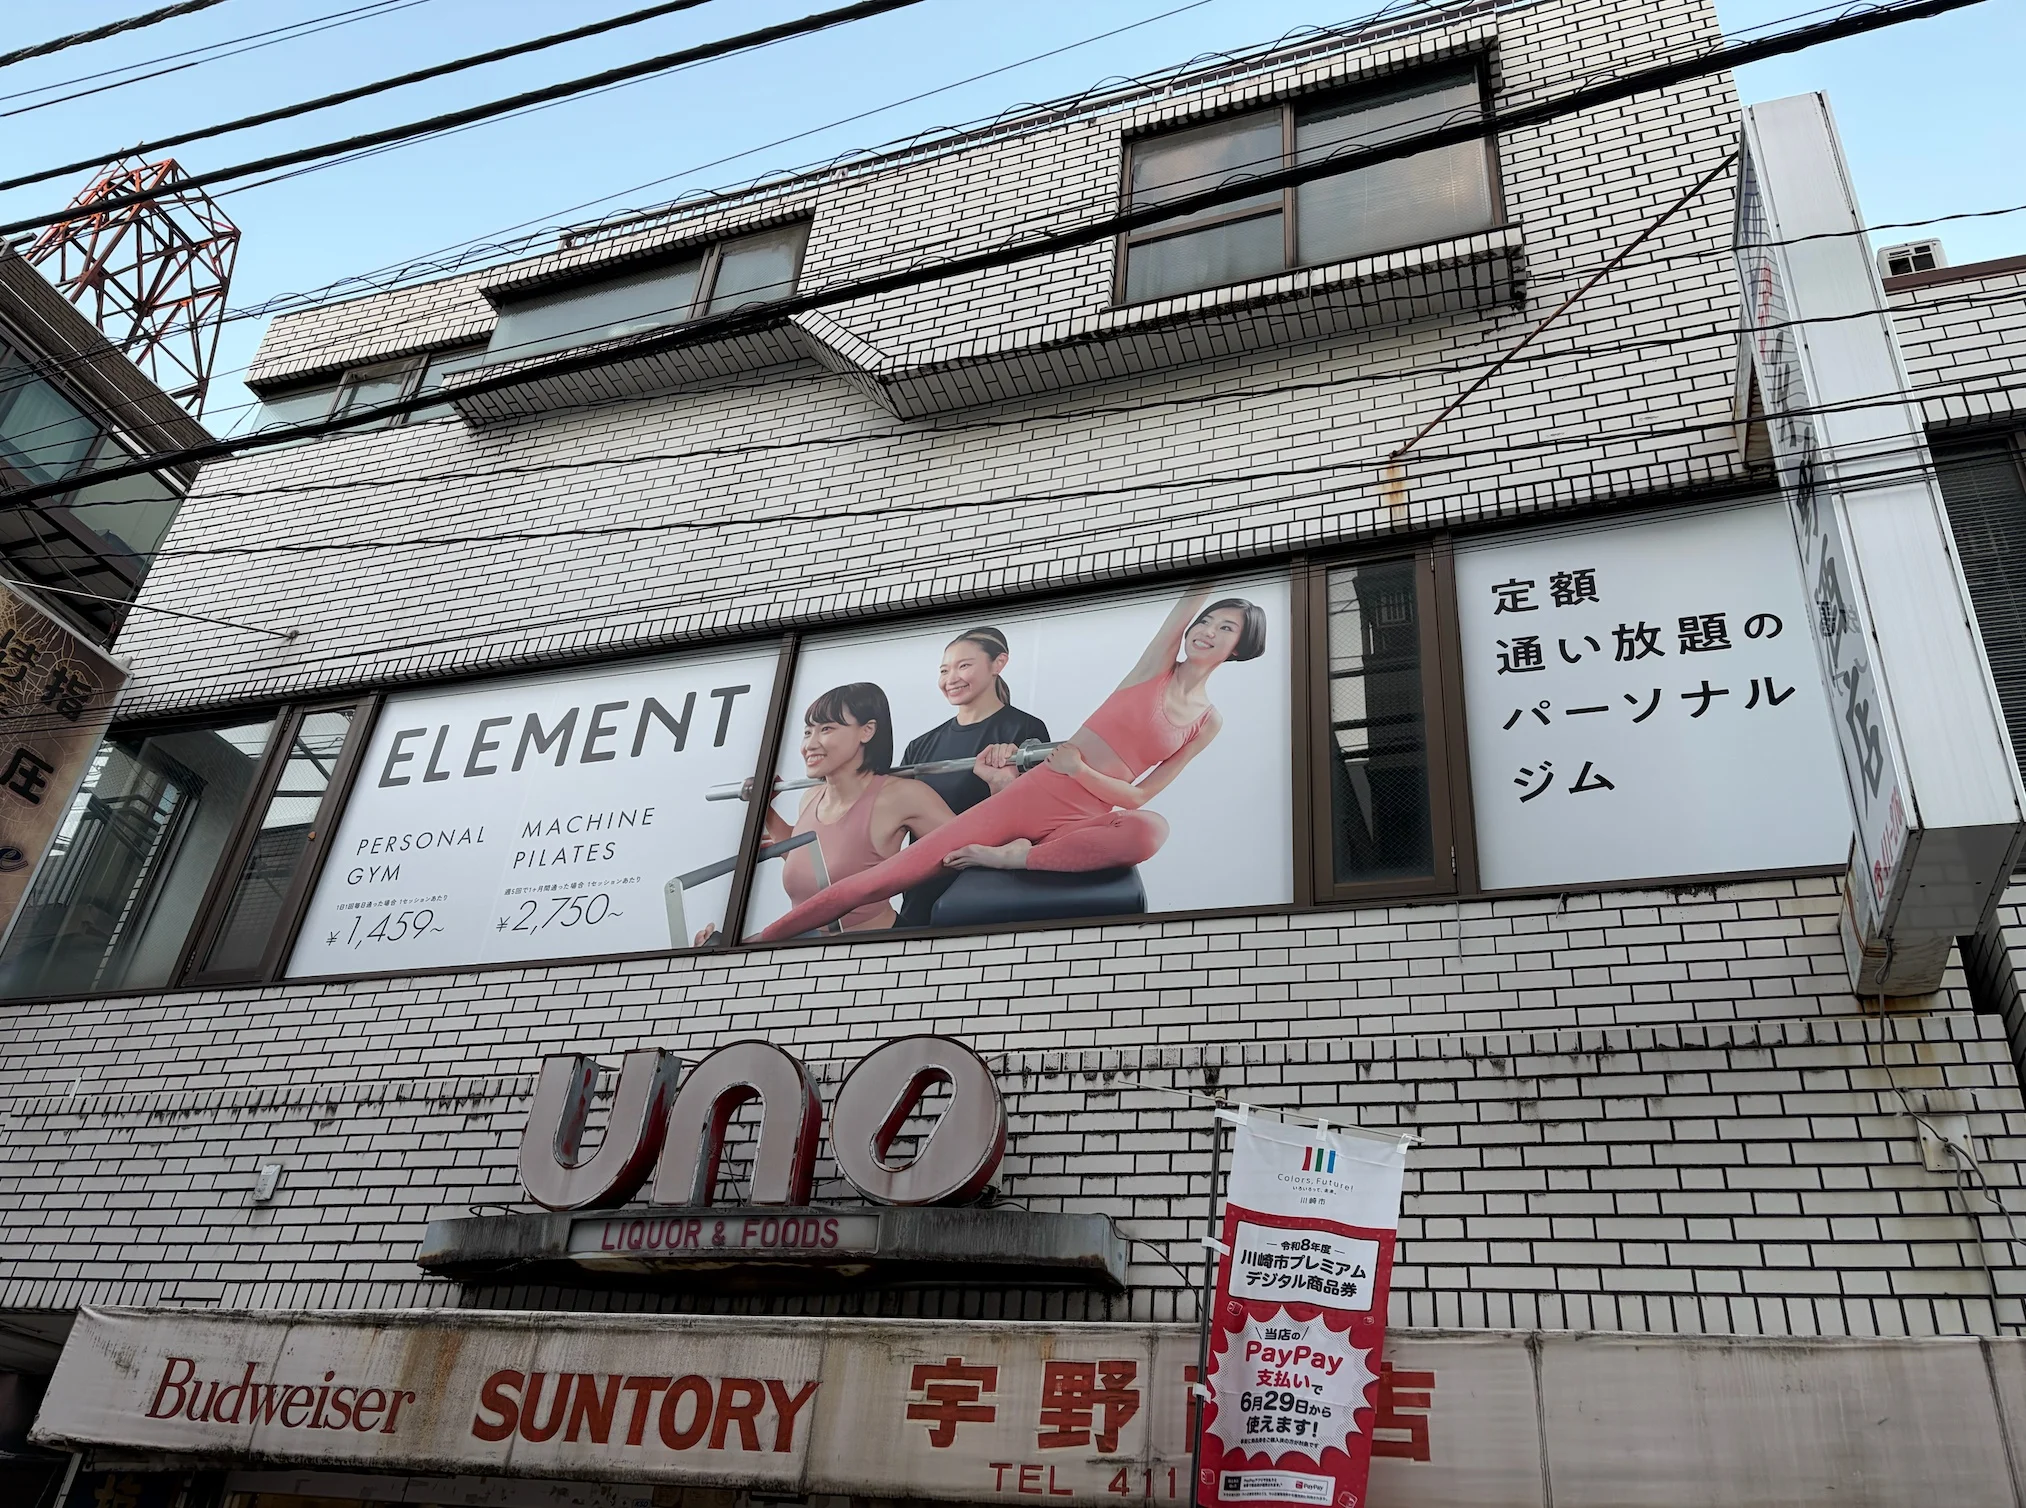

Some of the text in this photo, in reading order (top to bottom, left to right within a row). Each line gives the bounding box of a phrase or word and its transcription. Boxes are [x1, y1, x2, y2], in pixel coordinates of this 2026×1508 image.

[1491, 567, 1600, 615] 定額
[1496, 612, 1783, 675] 通い放題の
[1502, 676, 1796, 730] パーソナル
[1, 664, 96, 804] 指圧
[378, 684, 751, 788] ELEMENT
[1513, 760, 1615, 804] ジム
[521, 807, 655, 839] MACHINE
[356, 825, 485, 856] PERSONAL
[513, 841, 617, 870] PILATES
[347, 865, 401, 886] GYM
[1277, 1173, 1354, 1192] Colors, Future!
[1300, 1197, 1326, 1205] 川崎市
[601, 1217, 841, 1251] LIQUOR & FOODS
[1281, 1239, 1332, 1255] 令和8年度
[1241, 1250, 1366, 1280] 川崎市プレミアム
[1246, 1271, 1358, 1298] デジタル商品券
[1265, 1329, 1301, 1341] 当店の
[1246, 1341, 1343, 1375] PayPay
[145, 1356, 415, 1435] Budweiser
[1256, 1369, 1323, 1395] 支払いで
[470, 1368, 823, 1453] SUNTORY
[1240, 1391, 1332, 1418] 6月29日から
[1247, 1416, 1319, 1437] 使えます!
[989, 1461, 1177, 1499] TEL 411
[1303, 1483, 1324, 1492] PayPay
